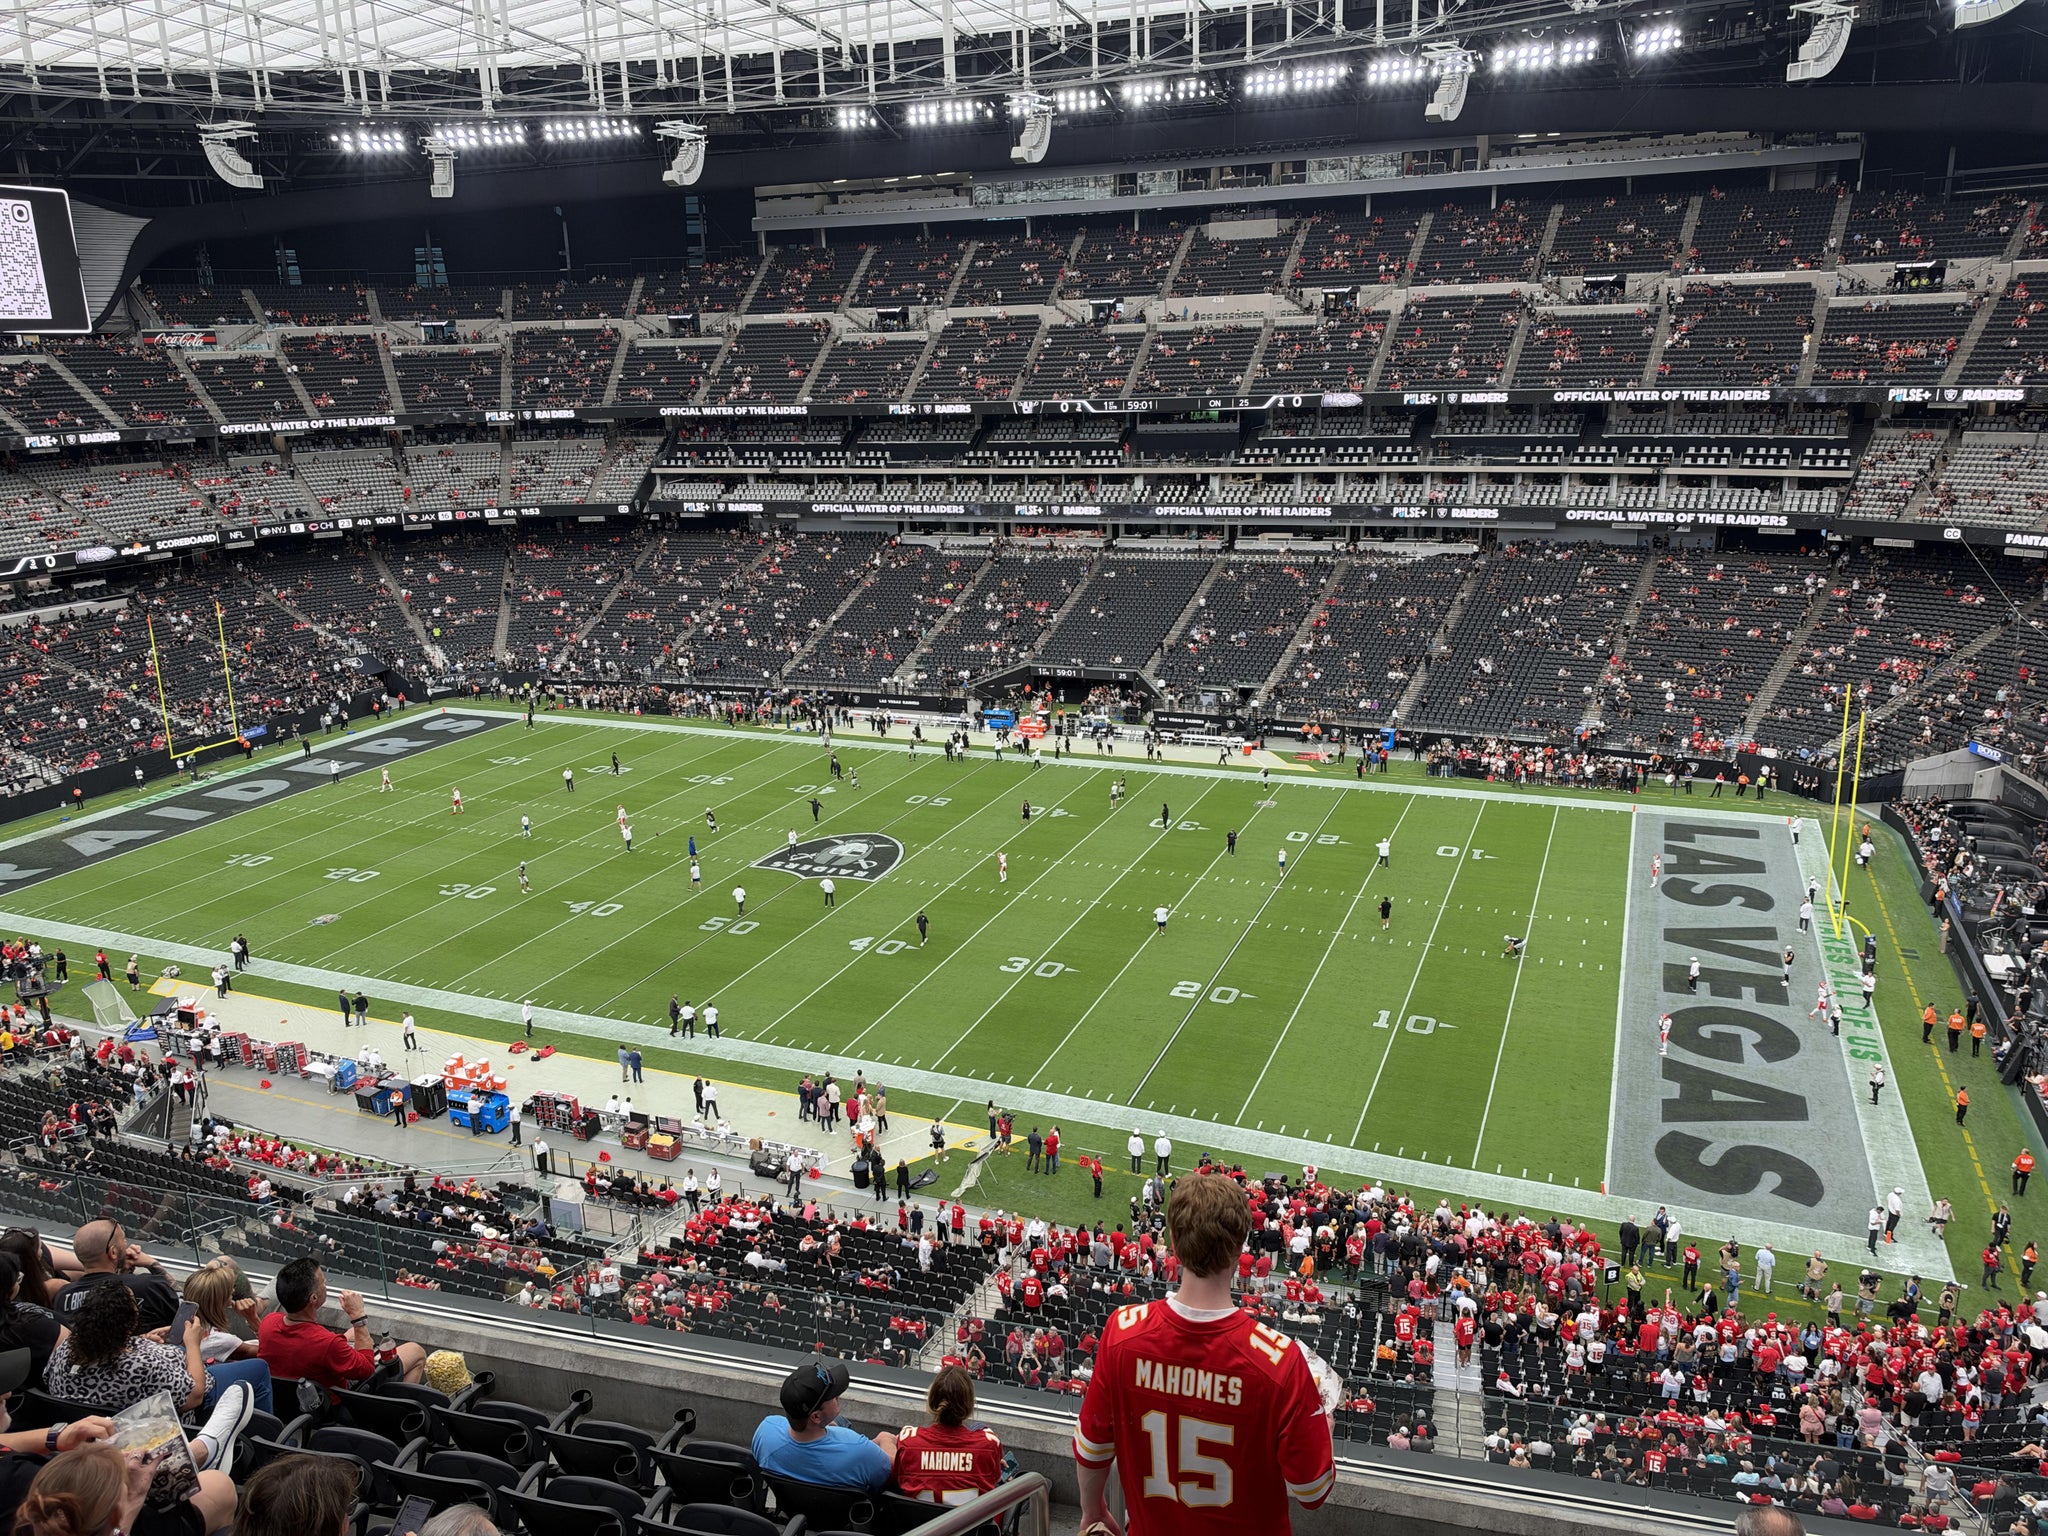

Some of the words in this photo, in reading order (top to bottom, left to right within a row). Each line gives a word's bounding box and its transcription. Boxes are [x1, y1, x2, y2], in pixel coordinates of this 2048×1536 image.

[1292, 396, 1302, 407] 0
[1461, 392, 1508, 403] RAIDERS
[1553, 390, 1612, 401] OFFICIAL
[1613, 390, 1660, 401] WATER
[1661, 390, 1681, 400] OF
[1682, 390, 1710, 400] THE
[1710, 390, 1770, 401] RAIDERS
[1962, 389, 2024, 401] RAIDERS
[935, 404, 971, 413] RAIDERS
[1060, 403, 1069, 412] 0
[1127, 401, 1153, 410] 59:01
[1239, 399, 1249, 407] 25
[535, 409, 575, 419] RAIDERS
[659, 407, 701, 416] OFFICIAL
[702, 407, 735, 415] WATER
[735, 406, 749, 415] OF
[749, 406, 768, 415] THE
[768, 406, 807, 415] RAIDERS
[220, 423, 270, 434] OFFICIAL
[271, 421, 309, 432] WATER
[310, 419, 325, 429] OF
[326, 418, 348, 428] THE
[349, 416, 396, 427] RAIDERS
[79, 432, 121, 444] RAIDERS
[420, 513, 436, 521] JAX
[502, 508, 517, 516] 4th
[520, 508, 540, 516] 11:53
[728, 503, 764, 512] RAIDERS
[812, 504, 854, 513] OFFICIAL
[854, 504, 888, 513] WATER
[889, 505, 902, 513] OF
[902, 505, 923, 513] THE
[923, 505, 965, 514] RAIDERS
[1063, 506, 1101, 515] RAIDERS
[1155, 506, 1203, 516] OFFICIAL
[1204, 506, 1243, 516] WATER
[1243, 507, 1258, 516] OF
[1259, 507, 1282, 516] THE
[1283, 507, 1332, 517] RAIDERS
[1451, 508, 1499, 519] RAIDERS
[271, 526, 287, 534] NYJ
[319, 522, 334, 530] CHI
[356, 518, 372, 526] 4th
[375, 516, 396, 525] 10:01
[1565, 509, 1626, 521] OFFICIAL
[1627, 510, 1674, 523] WATER
[1675, 512, 1696, 523] OF
[1697, 513, 1727, 525] THE
[1728, 514, 1788, 527] RAIDERS
[229, 531, 246, 539] NFL
[1945, 530, 1959, 538] CC
[2005, 533, 2048, 548] FANTA
[156, 534, 216, 550] SCOREBOARD
[45, 555, 56, 568] 0
[1056, 669, 1076, 677] 59:01
[1976, 744, 2001, 758] BOYD
[688, 774, 735, 786] 30
[794, 784, 837, 795] 40
[0, 717, 487, 887] RAIDERS
[905, 795, 953, 806] 50
[1285, 831, 1341, 845] 20
[225, 853, 274, 867] 10
[1436, 846, 1486, 860] 10
[770, 861, 869, 877] RAIDERS
[1661, 822, 1775, 912] LAS
[325, 868, 381, 883] 20
[440, 884, 497, 899] 30
[568, 900, 624, 917] 40
[699, 917, 761, 936] 50
[849, 936, 907, 956] 40
[1000, 957, 1065, 977] 30
[1829, 968, 1864, 999] ALL
[1169, 980, 1241, 1005] 20
[1372, 1010, 1437, 1035] 10
[1842, 1005, 1874, 1030] OF
[1847, 1034, 1883, 1062] US
[1654, 926, 1825, 1208] VEGAS
[1025, 1286, 1037, 1296] 87
[1399, 1323, 1410, 1334] 15
[1464, 1325, 1474, 1336] 15
[1250, 1322, 1293, 1366] 15
[1591, 1351, 1603, 1361] 15
[1135, 1357, 1243, 1407] MAHOMES
[920, 1450, 974, 1473] MAHOMES
[1141, 1409, 1234, 1508] 15
[1648, 1459, 1661, 1473] 15
